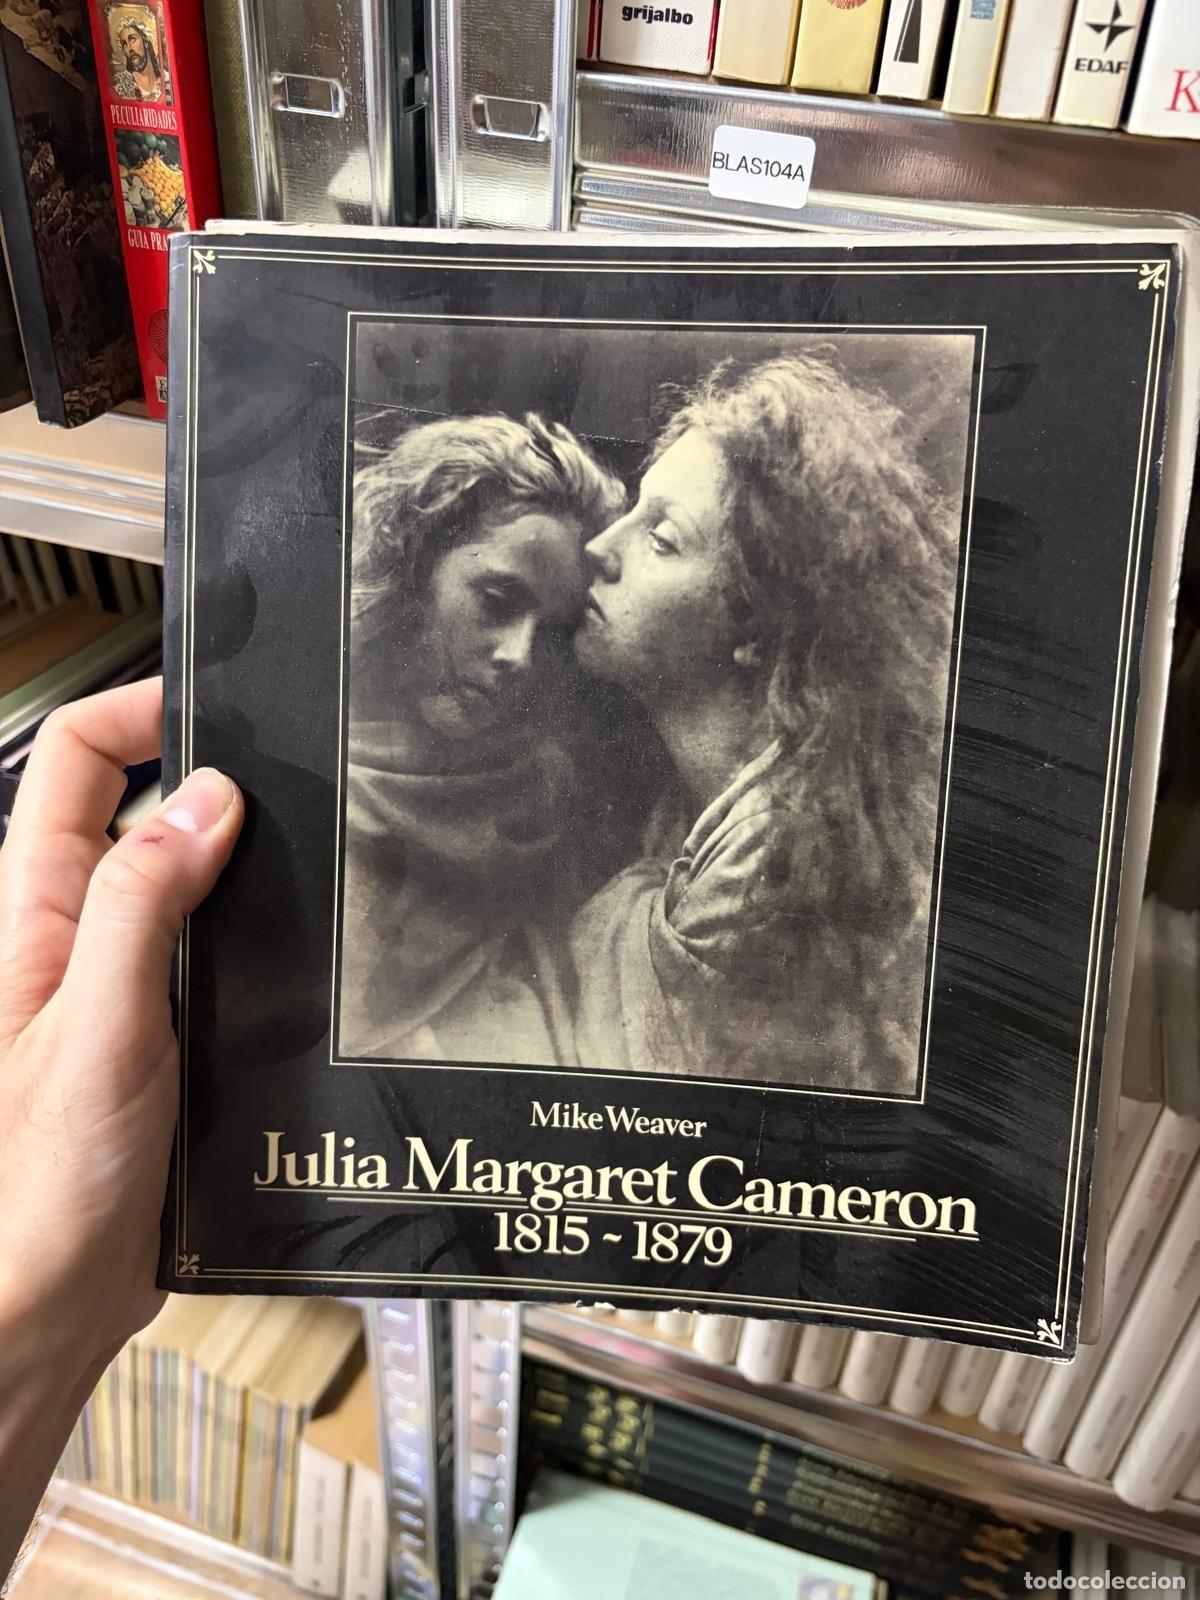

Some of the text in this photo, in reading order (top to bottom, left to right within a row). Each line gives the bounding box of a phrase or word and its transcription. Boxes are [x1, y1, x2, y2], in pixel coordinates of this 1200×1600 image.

[622, 5, 693, 25] grijalbo
[1074, 57, 1129, 75] EDAF
[110, 104, 177, 131] PECULIARIDADES
[712, 151, 805, 182] BLAS104A
[127, 228, 150, 250] GUIA
[530, 1101, 707, 1138] Mike Weaver
[254, 1131, 980, 1235] Julia Margaret Cameron
[494, 1211, 590, 1256] 1815
[632, 1221, 733, 1268] 1879
